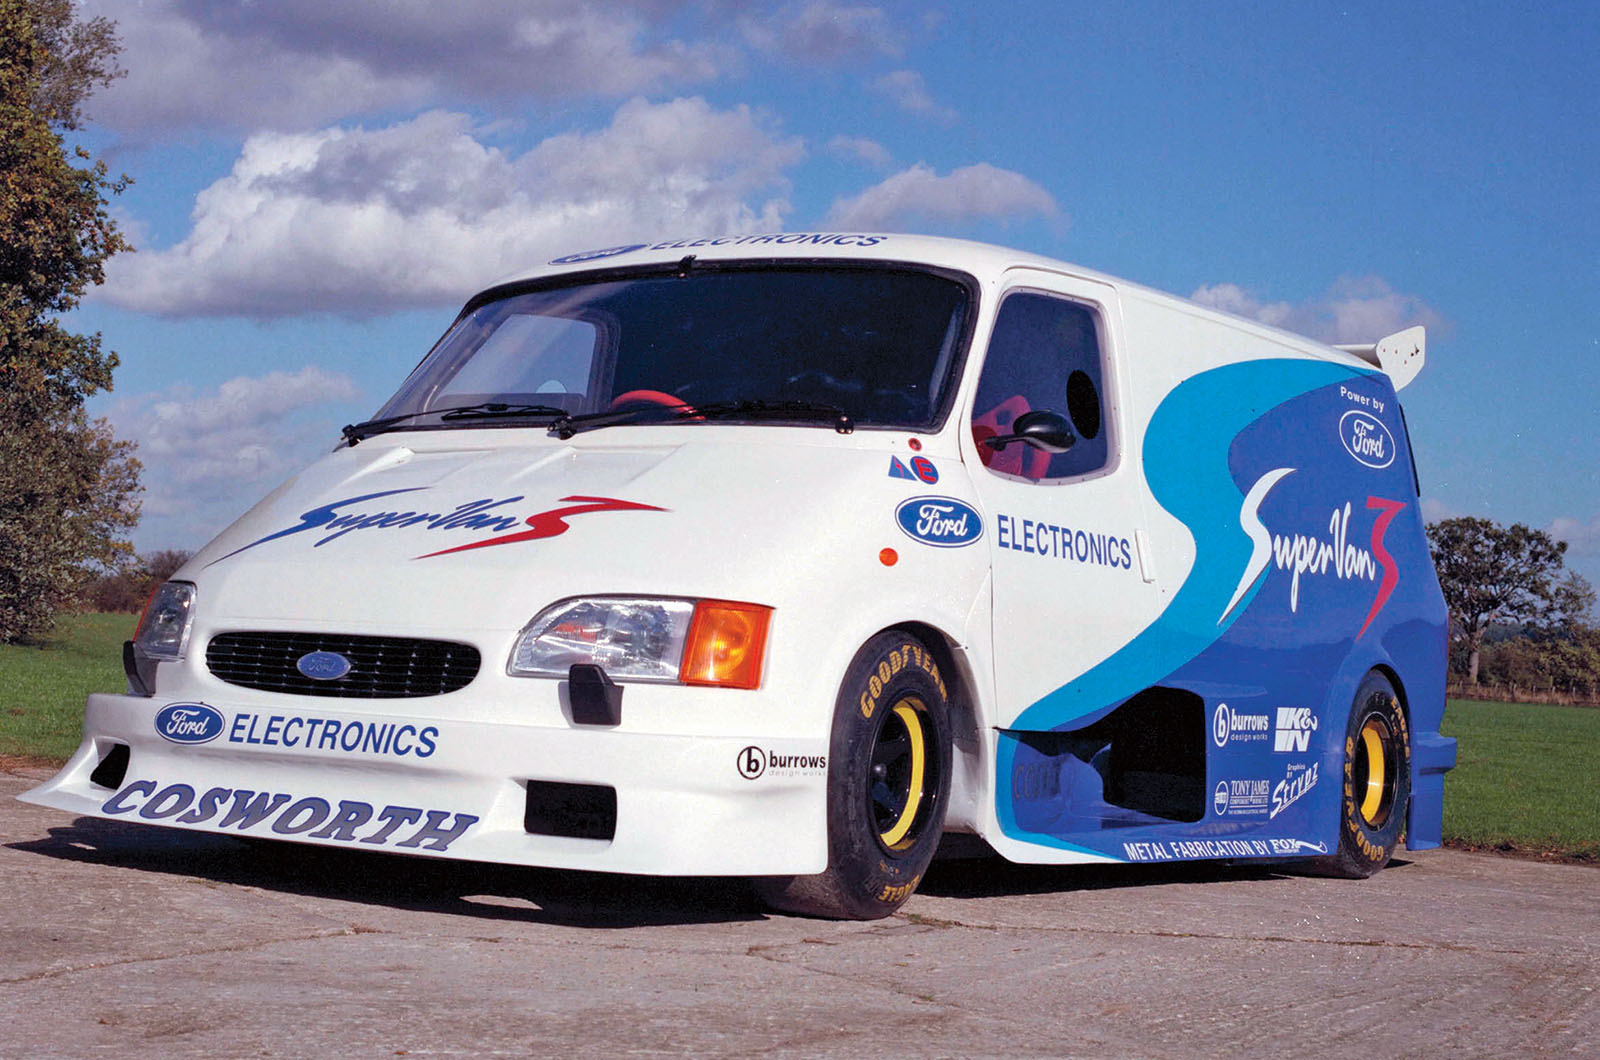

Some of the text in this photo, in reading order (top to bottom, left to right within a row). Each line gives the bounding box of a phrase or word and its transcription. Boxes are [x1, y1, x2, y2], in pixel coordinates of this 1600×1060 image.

[650, 234, 888, 250] ELECTRONICS
[1340, 386, 1385, 413] Power by
[1352, 419, 1385, 458] Ford
[916, 504, 969, 537] Ford
[997, 514, 1132, 570] ELECTRONICS
[860, 644, 949, 718] GOODYEAR
[166, 710, 208, 737] Ford
[1231, 708, 1269, 731] burrows
[229, 713, 439, 758] ELECTRONICS
[769, 750, 827, 768] burrows
[1231, 780, 1250, 795] TONY
[1250, 779, 1270, 803] JAMES
[101, 780, 480, 853] COSWORTH
[1123, 838, 1300, 861] METAL FABRICATION BY FOX
